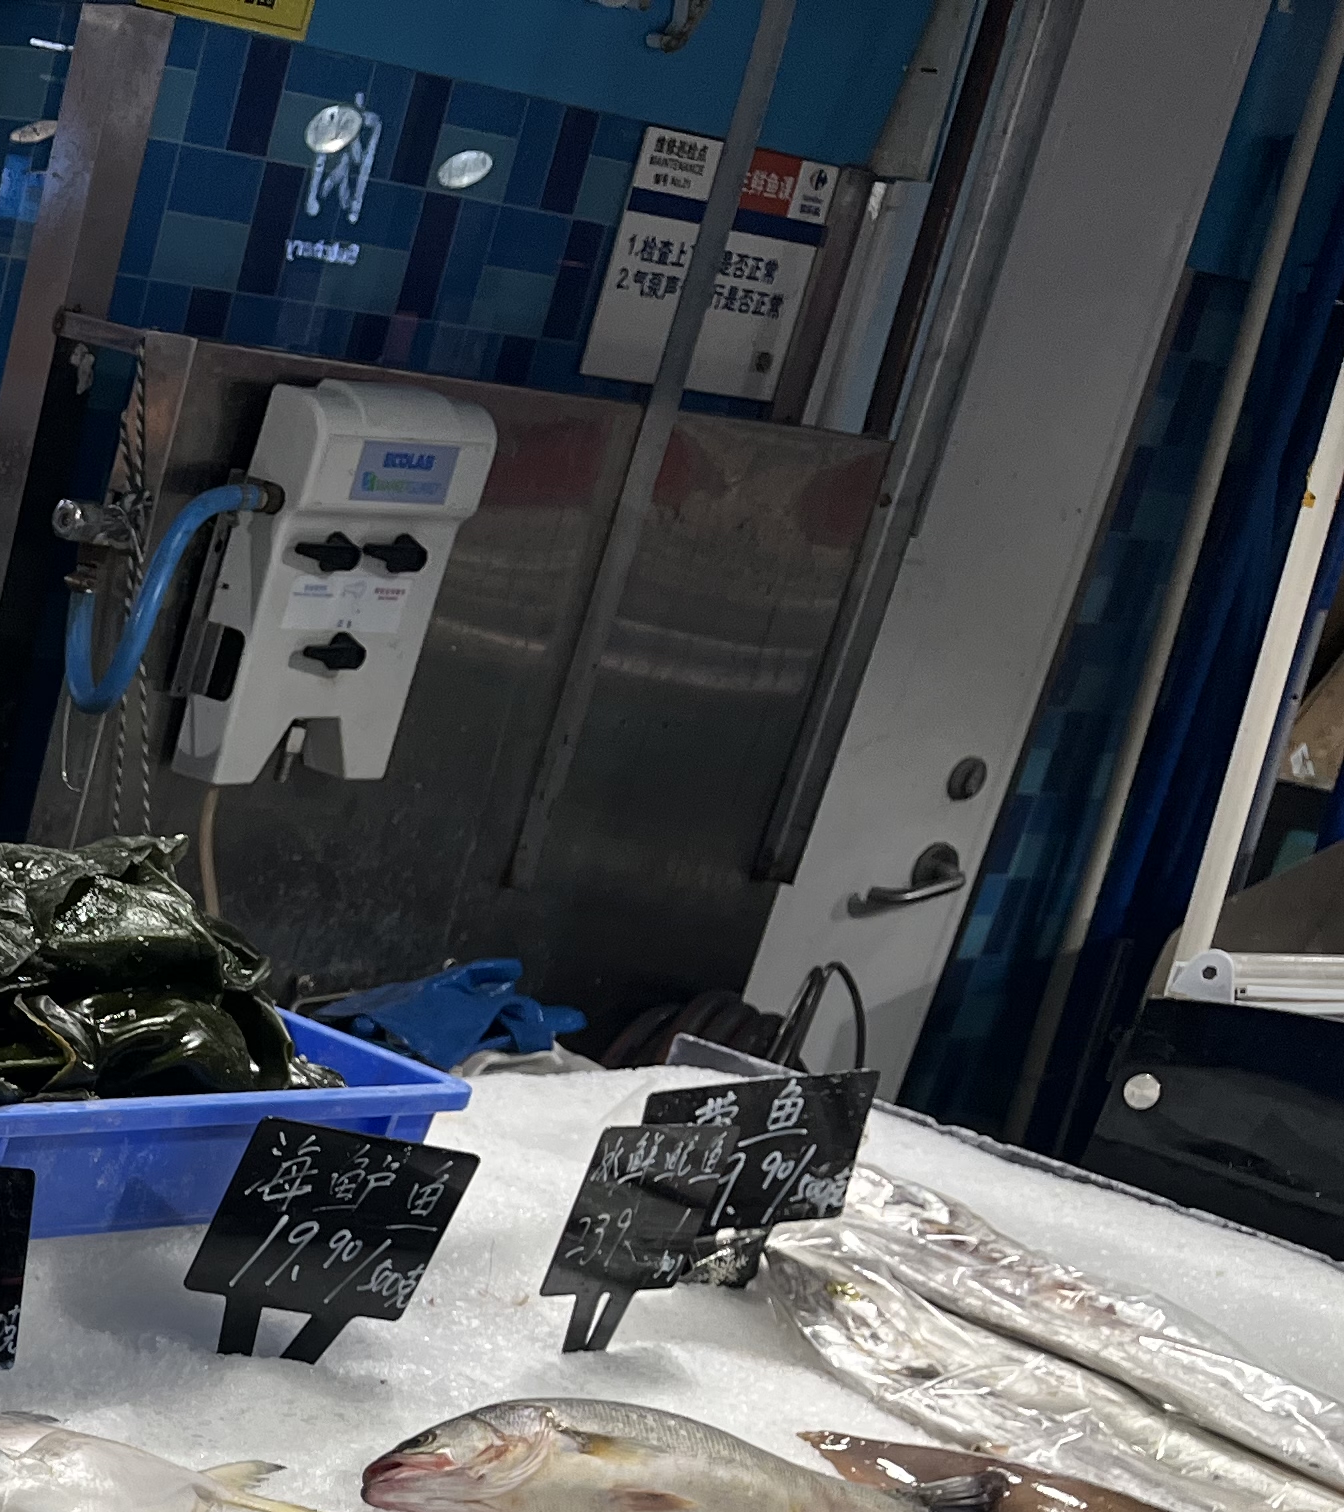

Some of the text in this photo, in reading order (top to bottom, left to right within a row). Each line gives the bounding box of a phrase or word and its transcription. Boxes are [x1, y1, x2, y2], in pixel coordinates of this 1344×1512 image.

[627, 234, 696, 268] 1.检查上
[244, 1131, 454, 1233] 海鲈鱼
